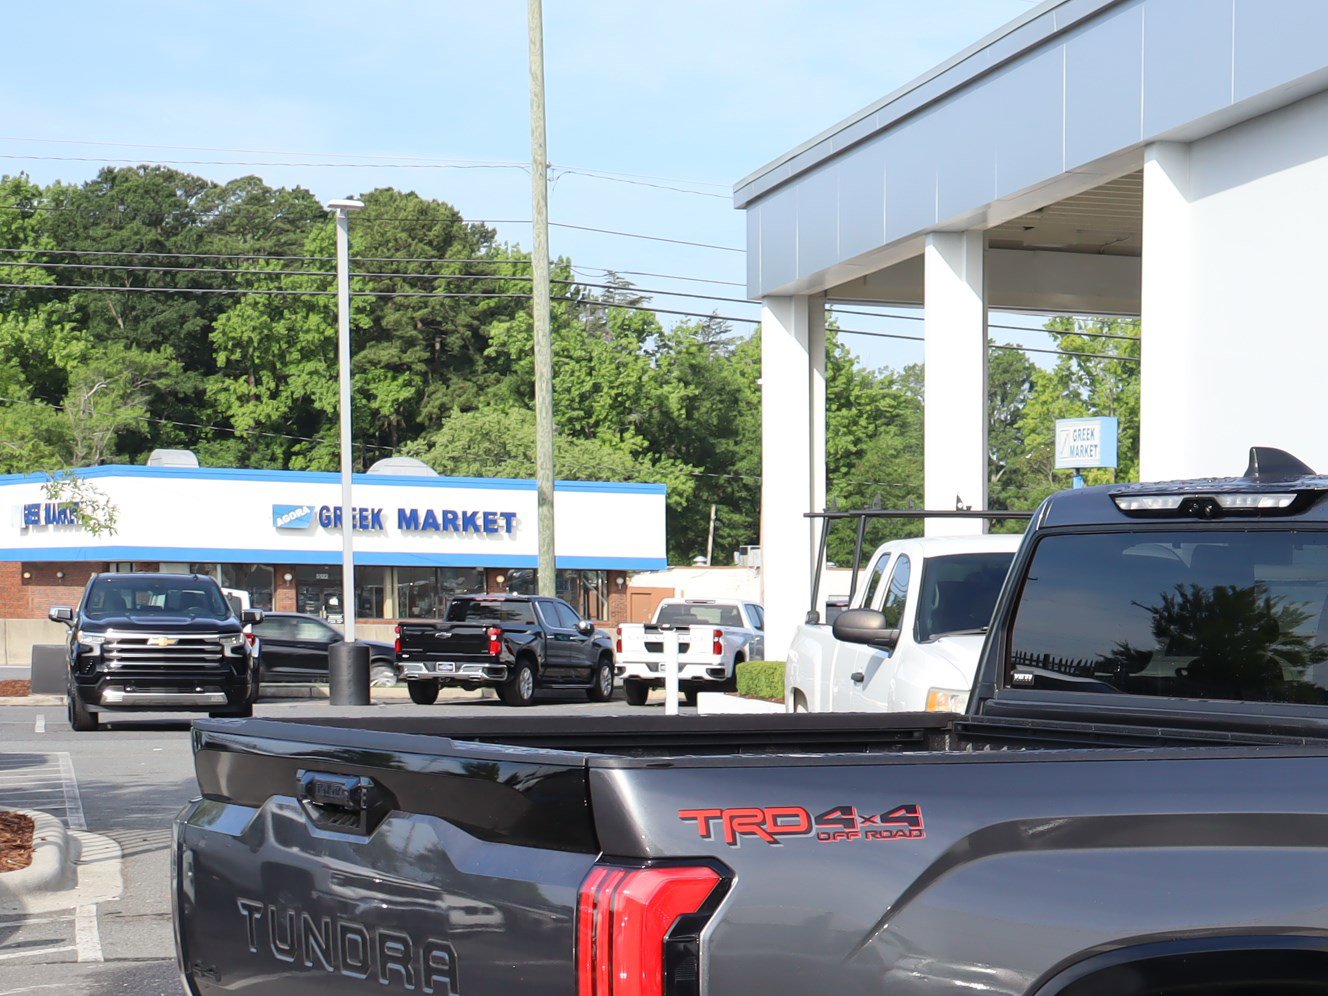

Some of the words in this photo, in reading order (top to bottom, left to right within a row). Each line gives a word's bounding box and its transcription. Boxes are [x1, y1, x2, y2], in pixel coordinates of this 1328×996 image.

[1072, 427, 1096, 442] GREEK
[1069, 444, 1098, 458] MARKET
[276, 505, 312, 527] AGORA
[397, 508, 517, 533] MARKET
[678, 805, 816, 848] TRD
[817, 831, 861, 842] OFF
[865, 829, 926, 841] ROAD
